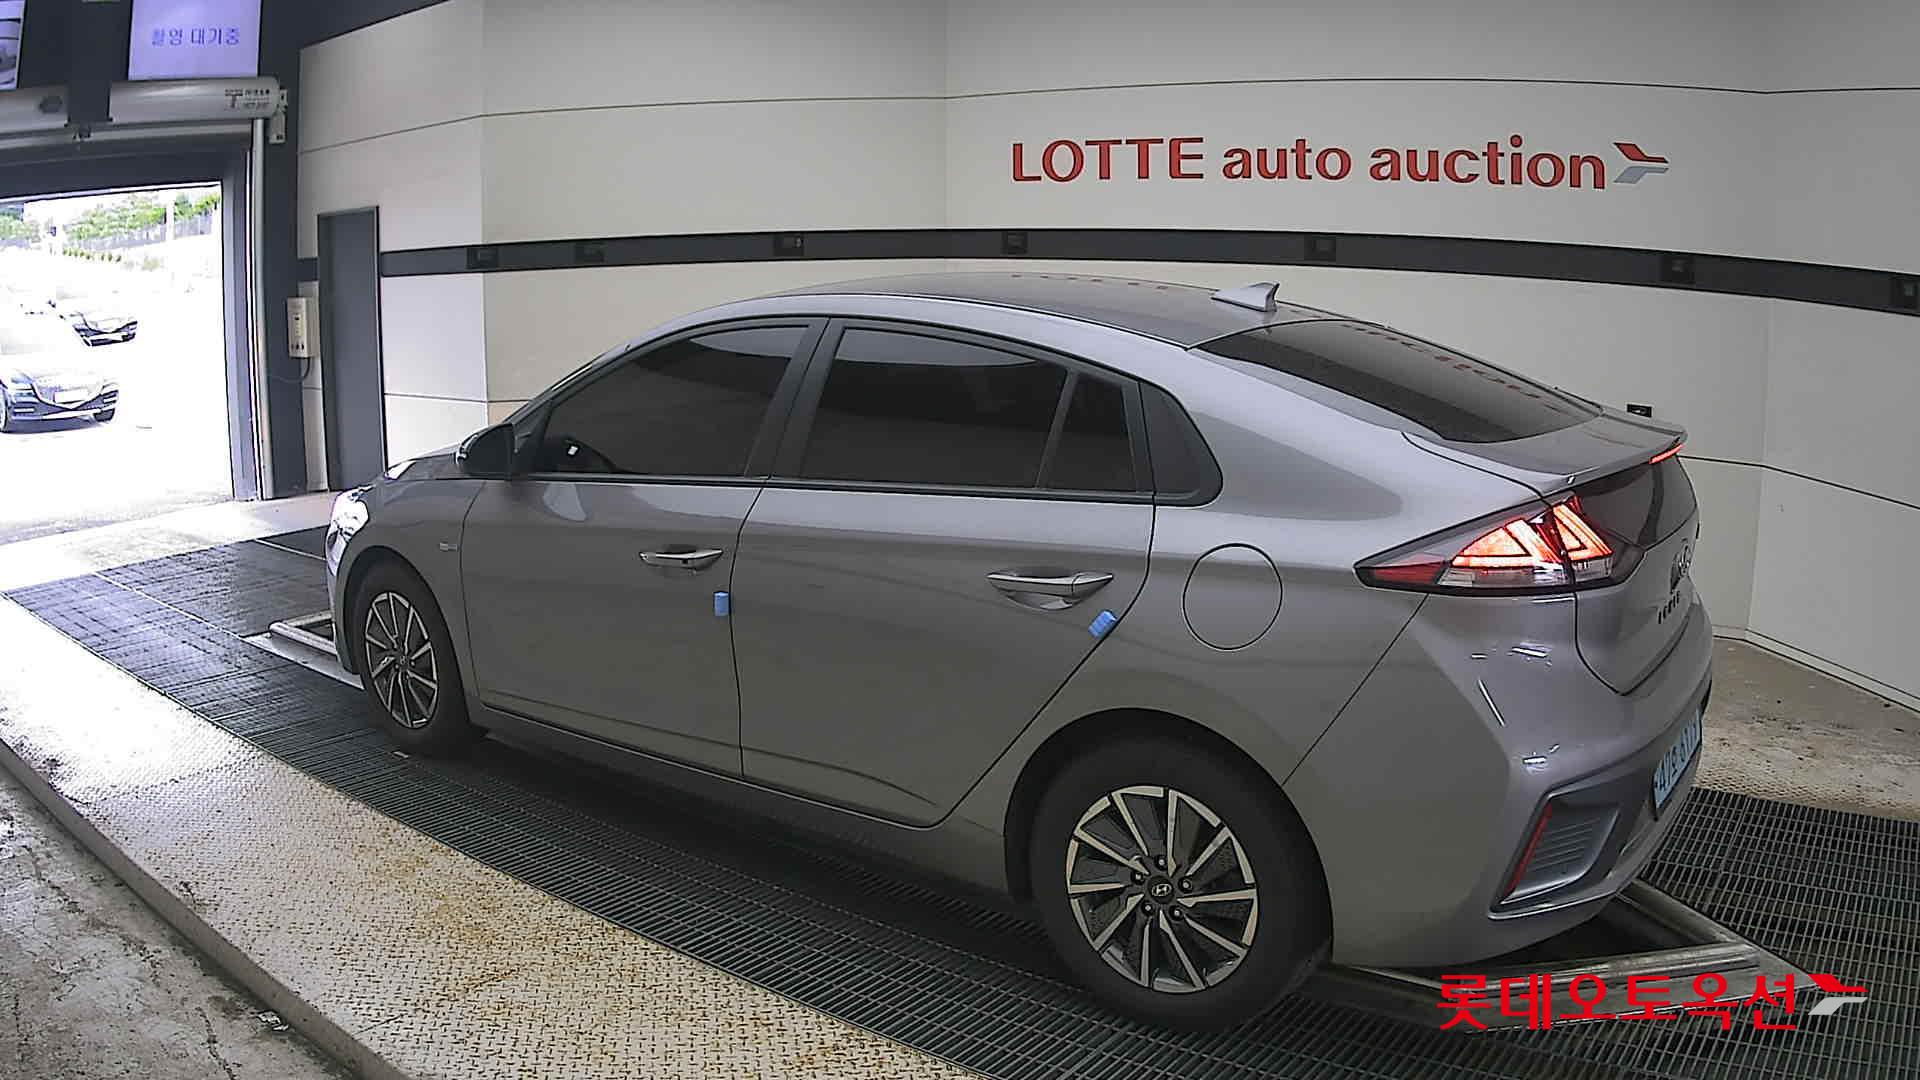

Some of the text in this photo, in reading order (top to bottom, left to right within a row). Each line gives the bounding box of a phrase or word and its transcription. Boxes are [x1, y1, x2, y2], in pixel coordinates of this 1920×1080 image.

[191, 27, 240, 46] 대기중
[1012, 134, 1606, 190] LOTTE auto auction
